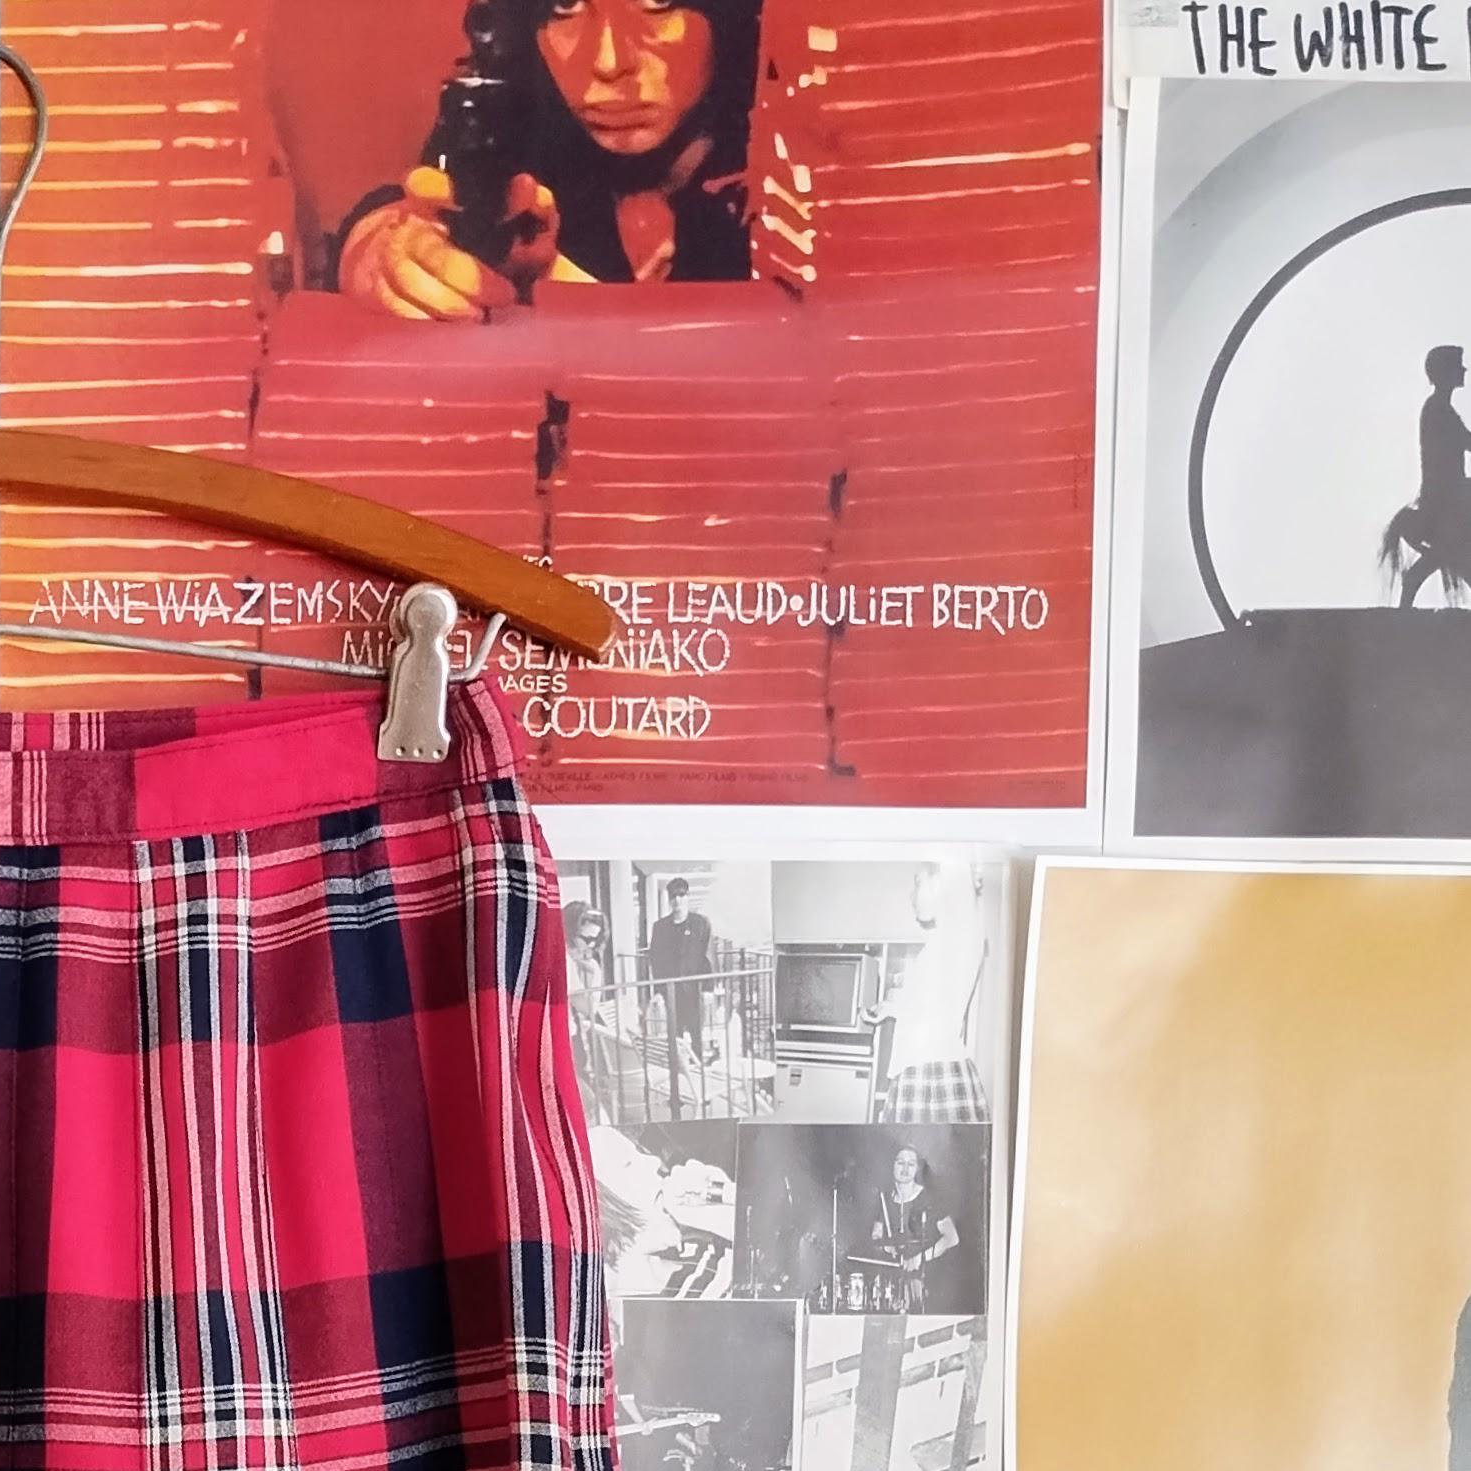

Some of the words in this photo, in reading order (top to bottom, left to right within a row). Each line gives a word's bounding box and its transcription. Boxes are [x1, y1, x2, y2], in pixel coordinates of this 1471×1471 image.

[1180, 0, 1277, 76] THE
[1292, 0, 1448, 73] WHITE
[28, 578, 149, 625] ANNE
[932, 583, 1049, 636] BERTO
[498, 673, 568, 694] AGES
[522, 694, 711, 740] COUTARD
